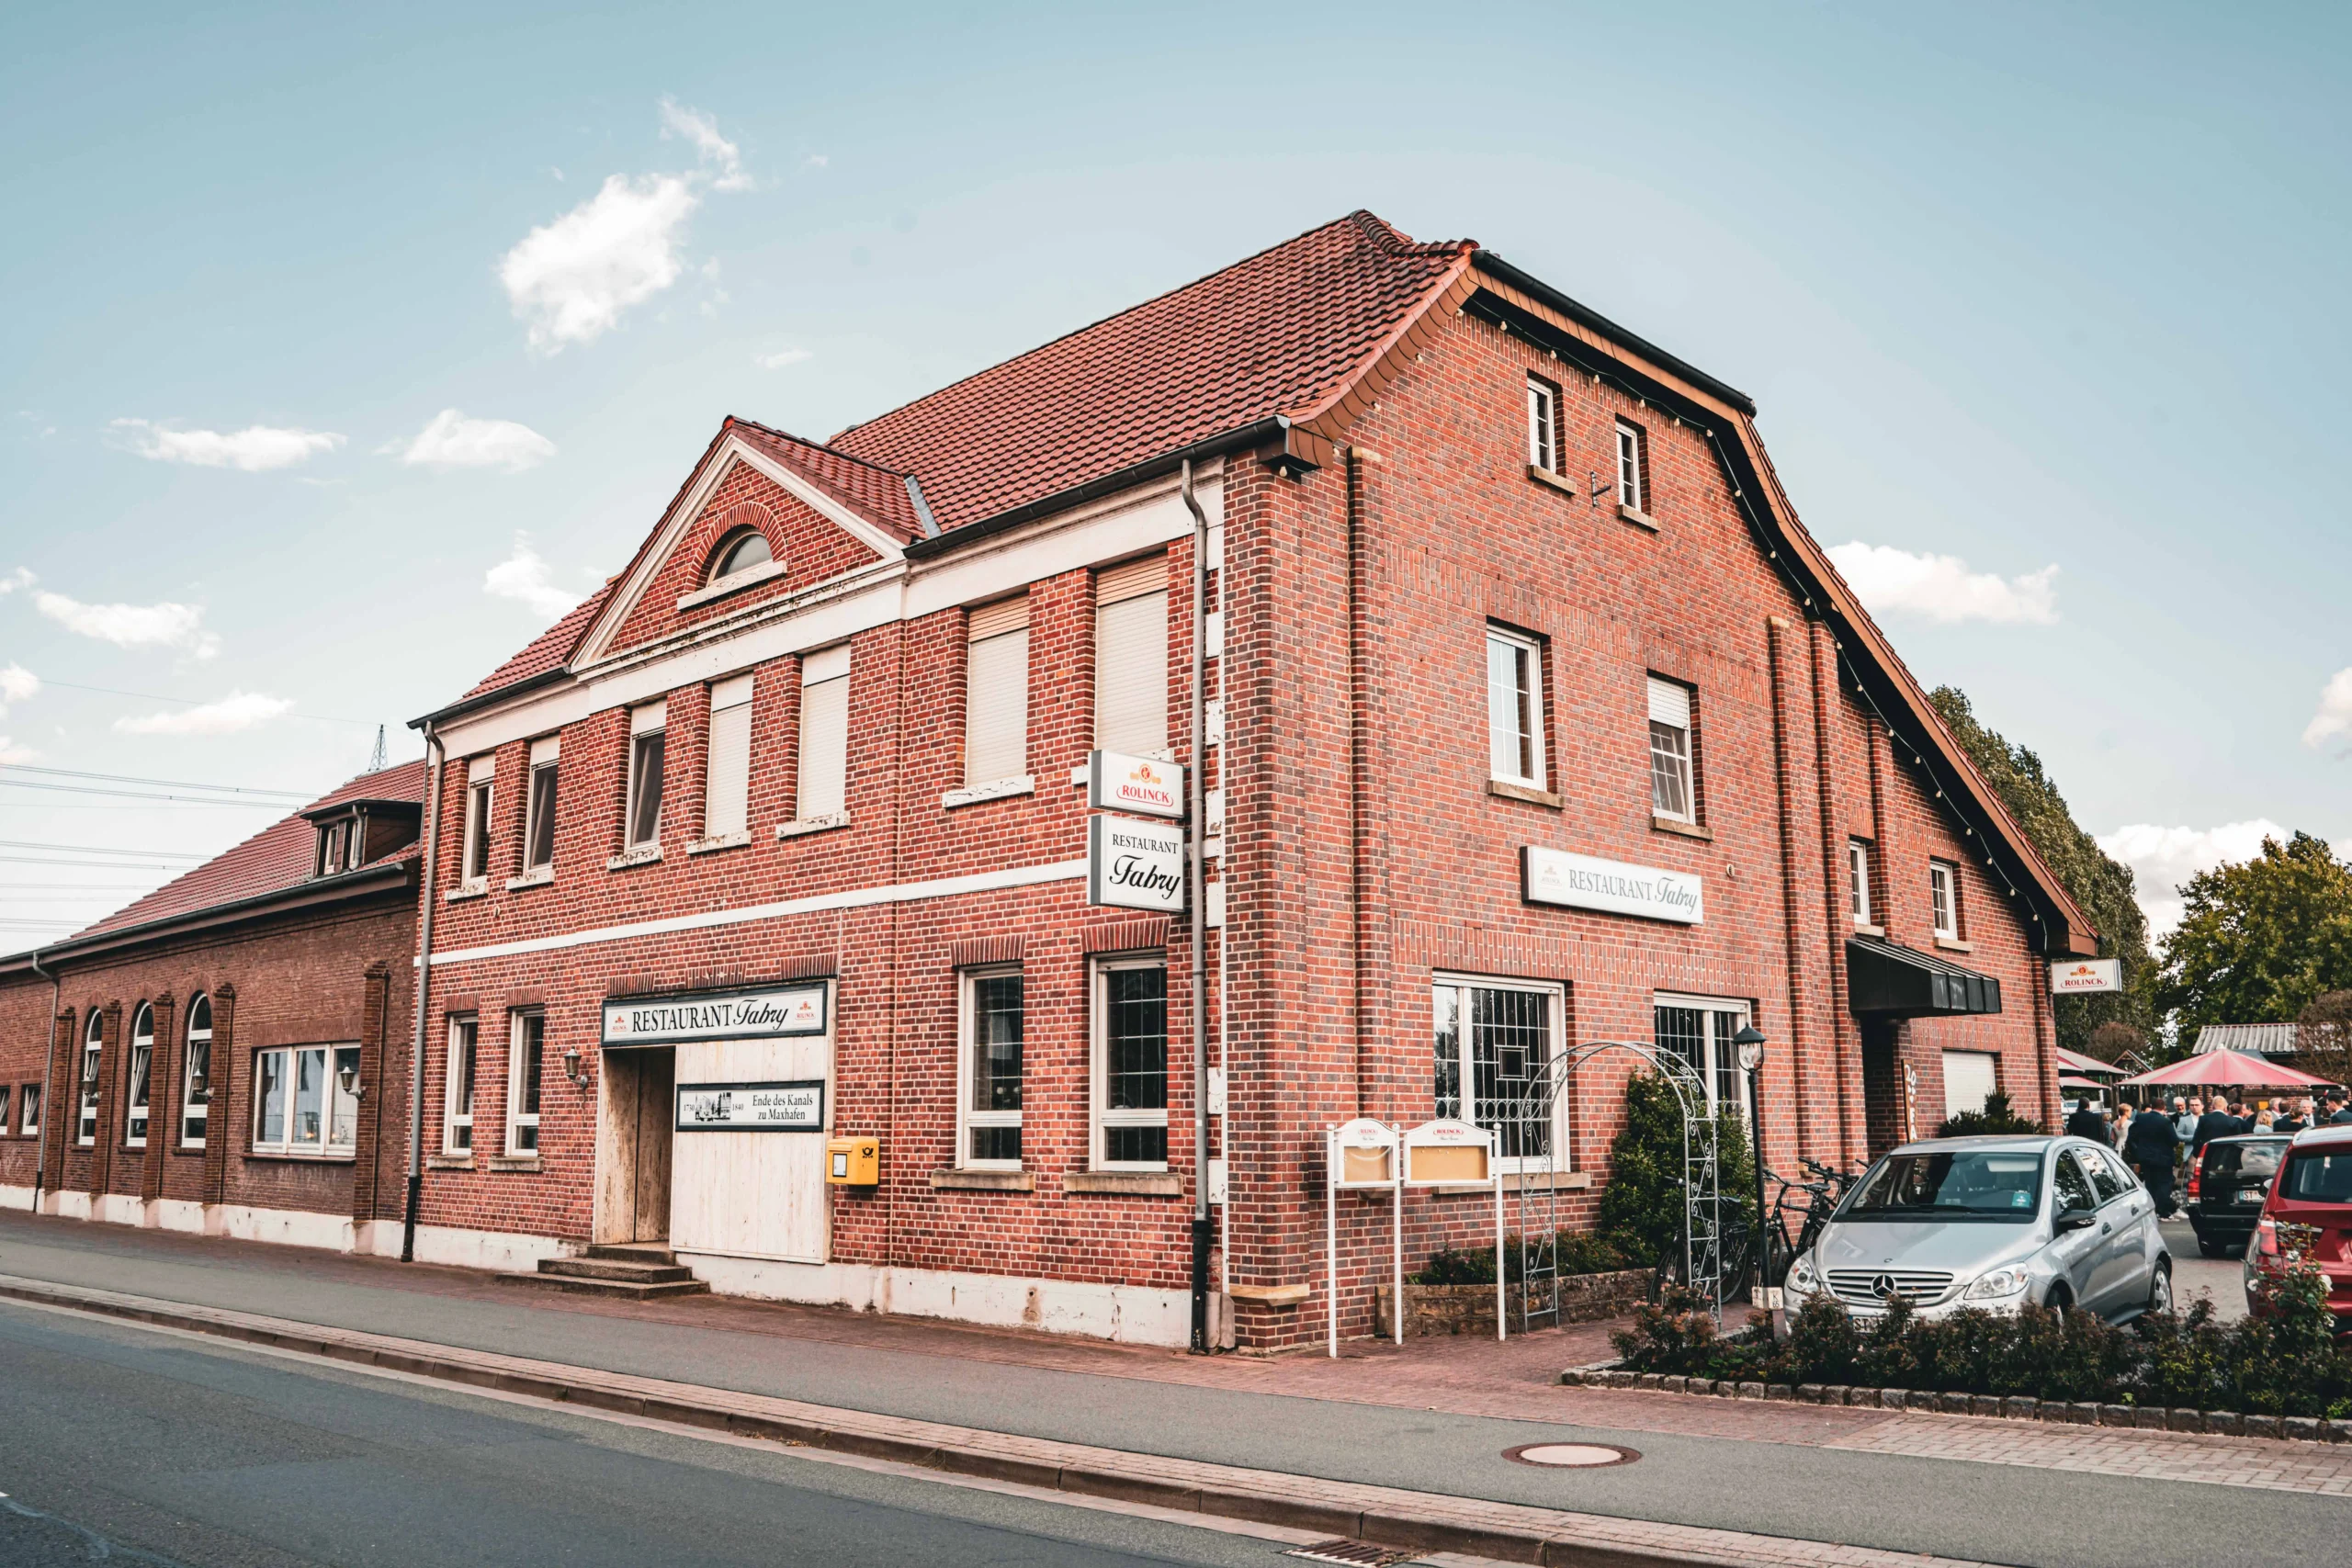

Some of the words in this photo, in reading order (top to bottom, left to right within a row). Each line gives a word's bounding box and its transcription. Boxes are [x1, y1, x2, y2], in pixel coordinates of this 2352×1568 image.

[1122, 784, 1170, 804] ROLINCK
[1112, 833, 1179, 854] RESTAURANT
[1109, 854, 1181, 900] Fabry
[1568, 869, 1653, 901] RESTAURANT
[1655, 876, 1698, 915] Fabry
[2064, 978, 2104, 987] ROLINCK
[631, 1004, 733, 1032] RESTAURANT
[732, 998, 789, 1031] Fabry
[752, 1094, 772, 1107] Ende
[773, 1093, 786, 1106] des
[787, 1093, 813, 1106] Kanals
[758, 1111, 767, 1120] zu
[768, 1107, 806, 1120] Maxhafen
